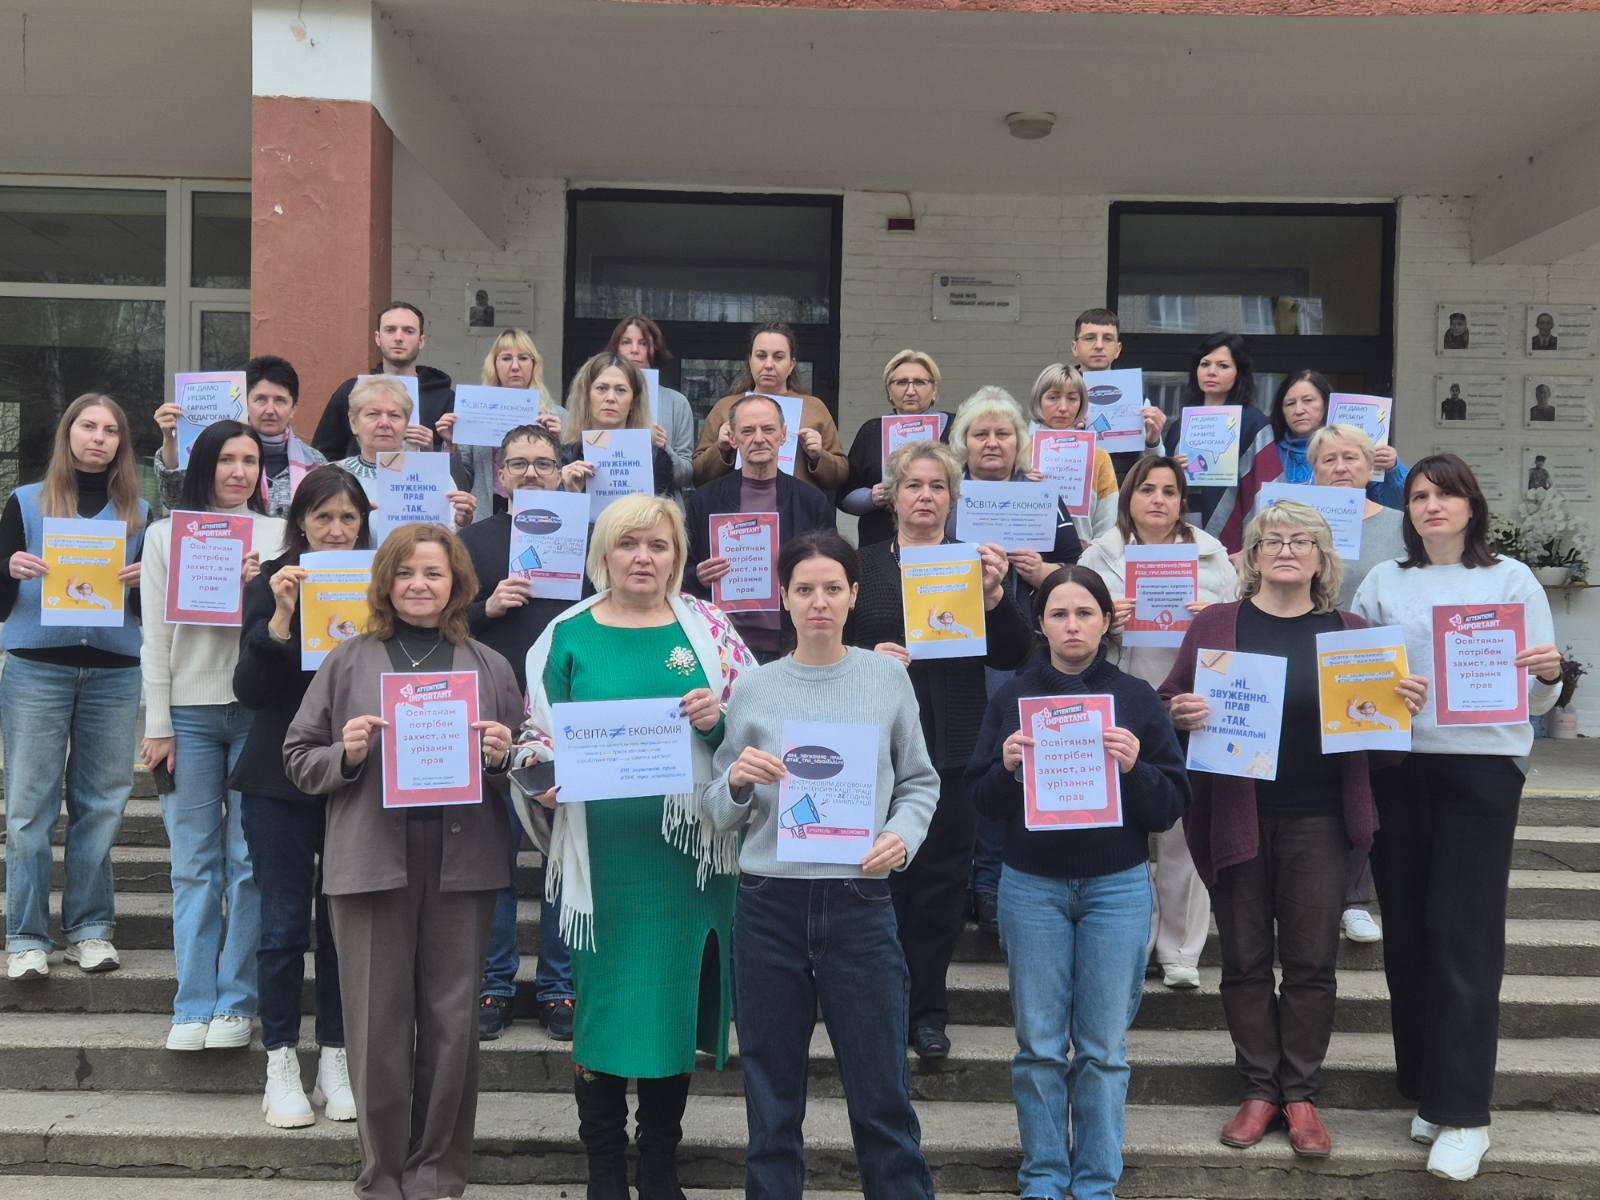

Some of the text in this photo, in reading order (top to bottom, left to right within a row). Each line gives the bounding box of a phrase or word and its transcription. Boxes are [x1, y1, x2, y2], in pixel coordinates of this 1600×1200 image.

[966, 500, 997, 510] ОСВІТА
[1012, 501, 1052, 510] ЕКОНОМІЯ
[193, 529, 232, 537] IMPORTANT
[191, 574, 228, 582] урізання
[728, 576, 762, 584] урізання
[1458, 620, 1500, 631] IMPORTANT
[1458, 649, 1501, 657] потрібен
[1460, 671, 1501, 679] урізання
[409, 690, 453, 702] IMPORTANT
[1225, 701, 1250, 712] ПРАВ
[406, 709, 456, 717] Освітянам
[1045, 712, 1088, 726] IMPORTANT
[409, 721, 453, 729] потрібен
[565, 728, 608, 740] ОСВІТА
[628, 724, 682, 737] ЕКОНОМІЯ
[1041, 738, 1095, 747] Освітянам
[411, 745, 453, 754] урізання
[1045, 751, 1093, 761] потрібен
[421, 758, 444, 766] прав
[1039, 767, 1078, 776] захист,
[1047, 779, 1094, 790] урізання
[1059, 793, 1085, 802] прав
